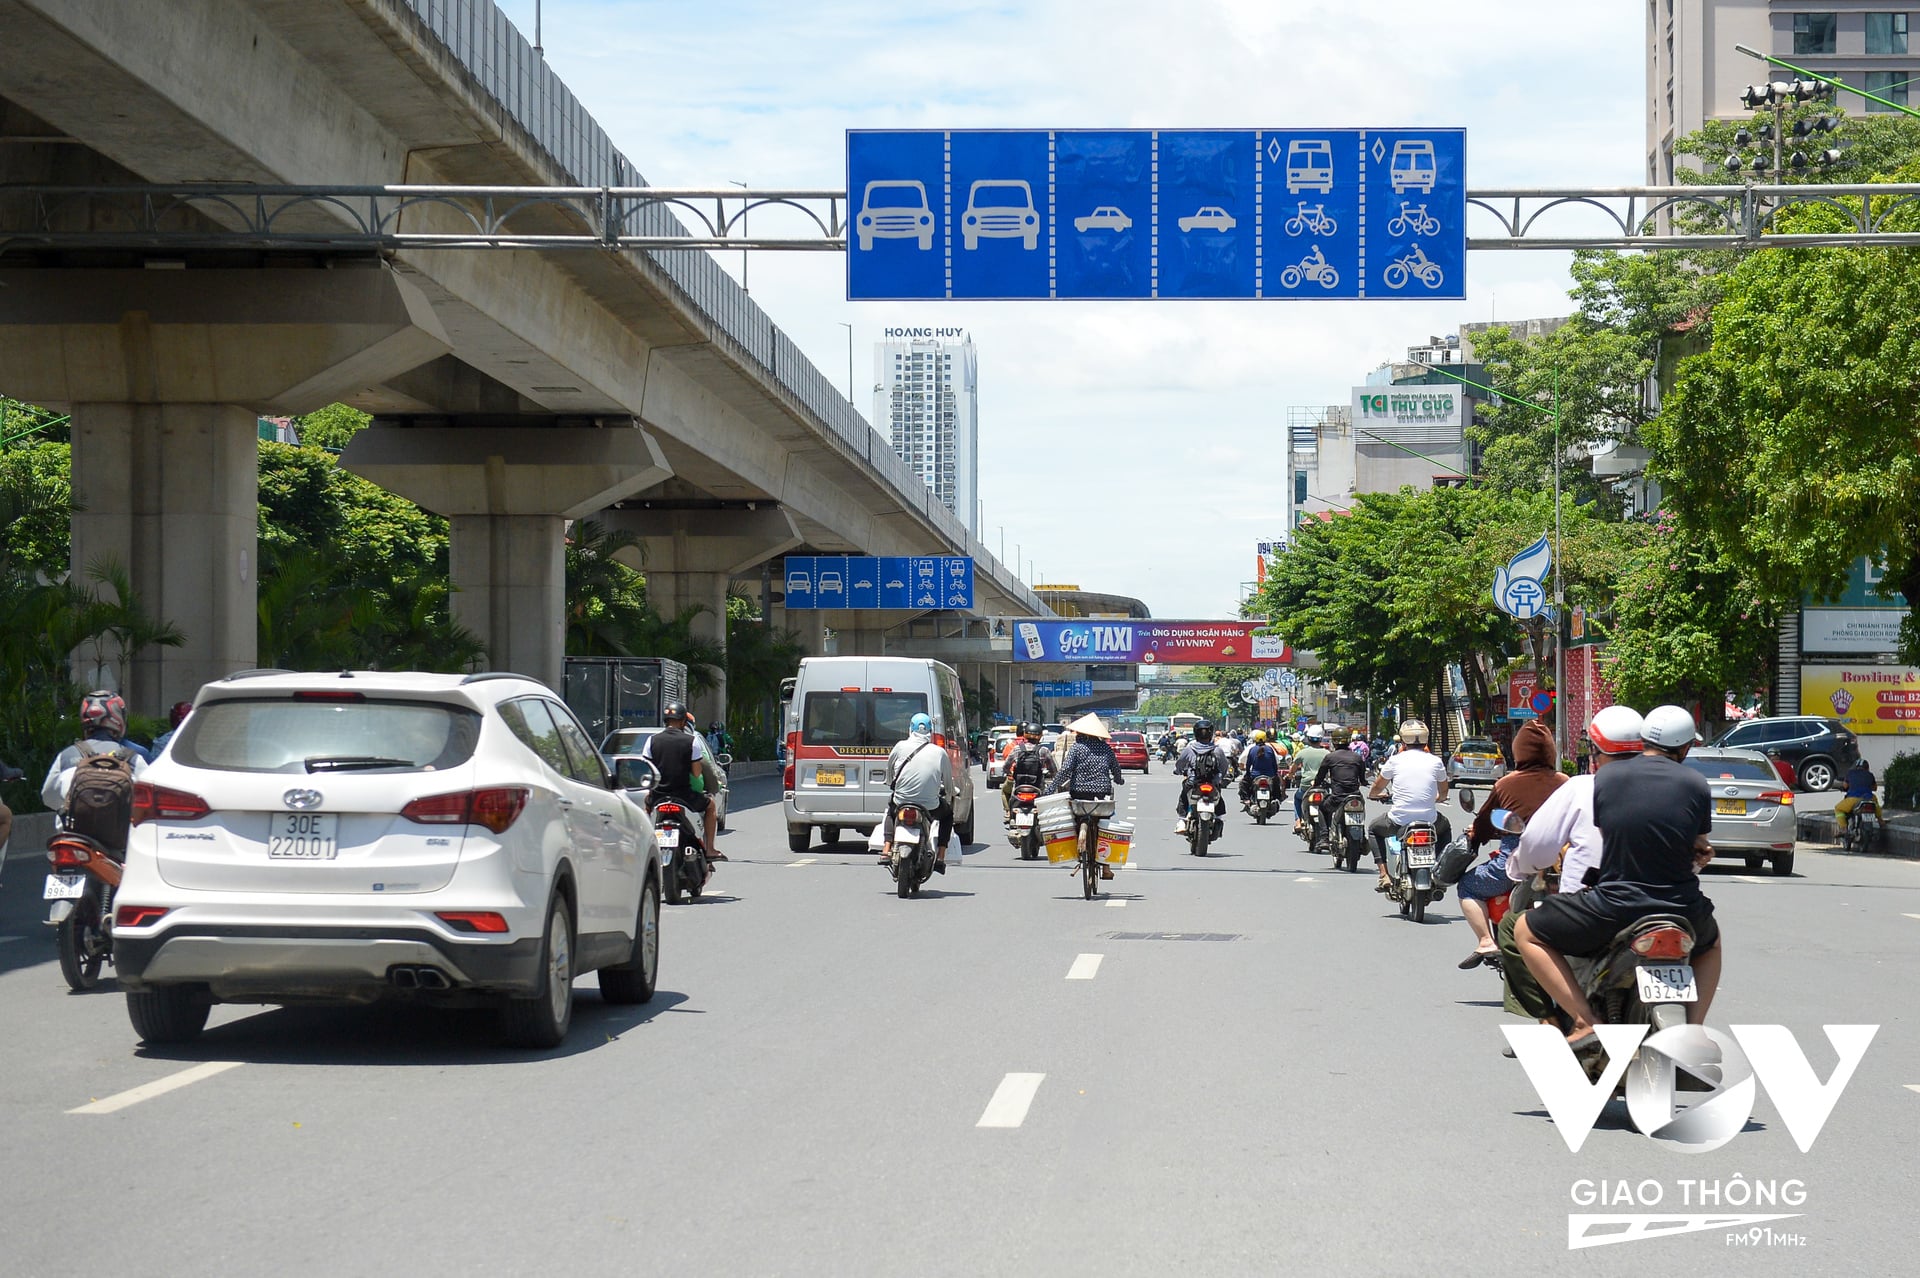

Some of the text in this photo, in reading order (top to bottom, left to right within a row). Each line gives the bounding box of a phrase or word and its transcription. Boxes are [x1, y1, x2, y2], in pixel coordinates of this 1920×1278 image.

[885, 328, 963, 337] HOANG HUY
[1391, 401, 1417, 412] THU
[1257, 542, 1271, 554] 094
[1152, 628, 1170, 637] ỨNG
[1171, 629, 1195, 639] DỤNG
[1196, 628, 1220, 637] NGÂN
[1221, 628, 1245, 637] HÀNG
[1832, 629, 1853, 637] PHÒNG
[1059, 627, 1132, 653] Gọi TAXI
[1842, 672, 1915, 685] Bowling &
[1881, 690, 1906, 703] Tầng
[287, 815, 322, 834] 30E
[271, 836, 332, 857] 220.01
[1647, 968, 1684, 984] 19-C1
[1644, 984, 1691, 999] 032.47
